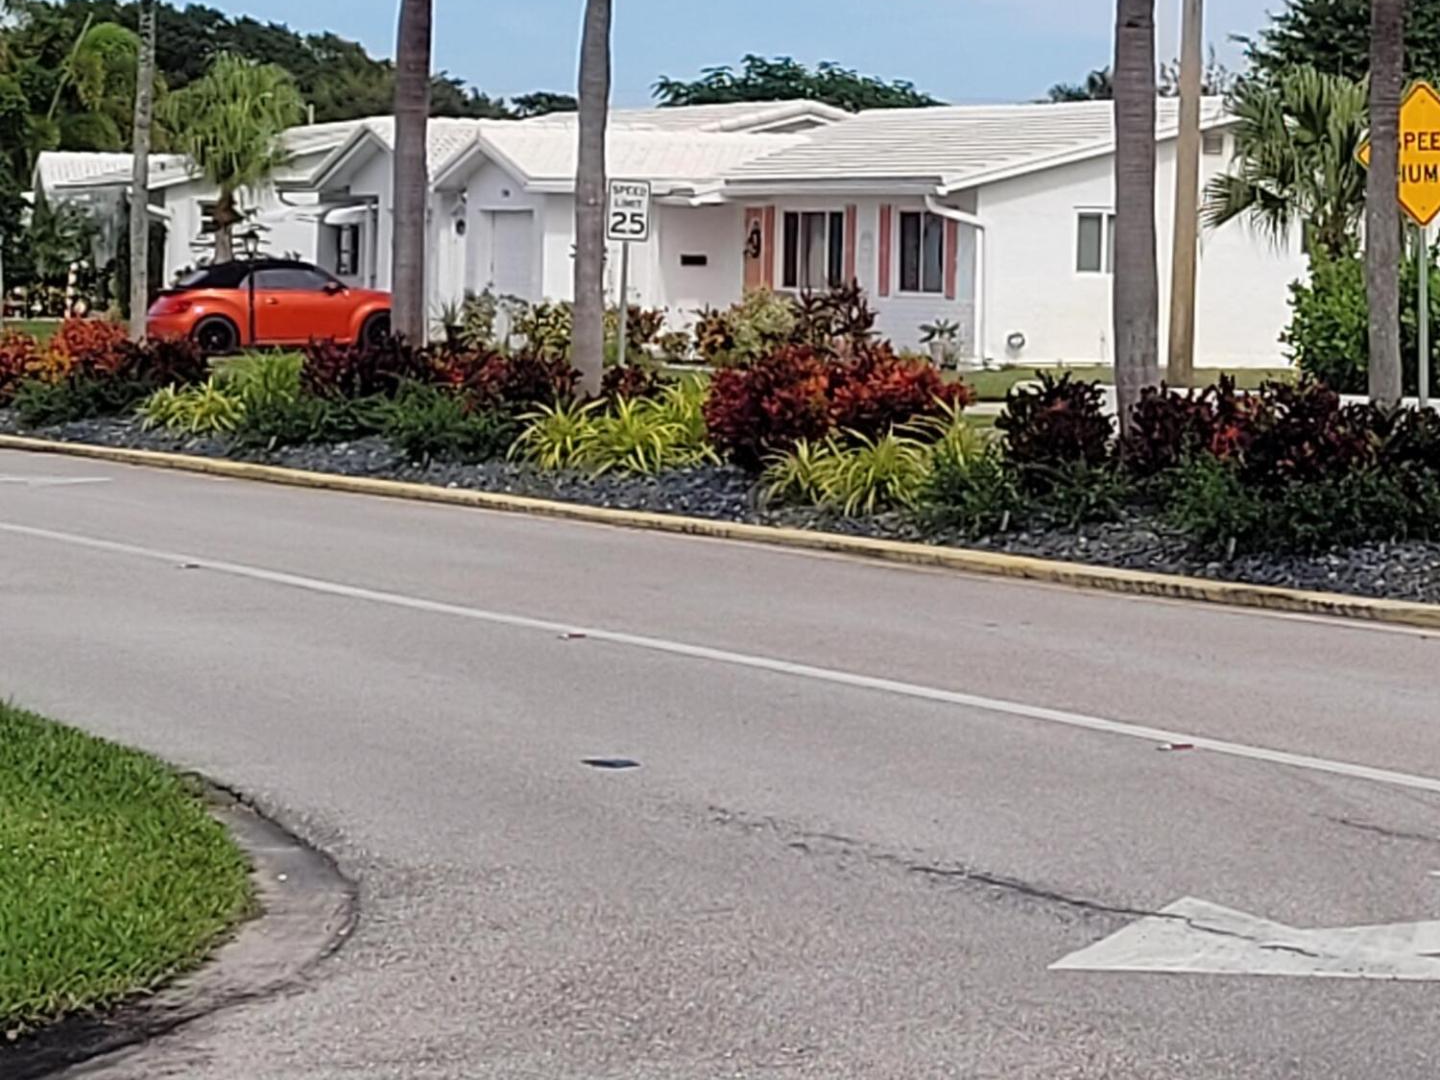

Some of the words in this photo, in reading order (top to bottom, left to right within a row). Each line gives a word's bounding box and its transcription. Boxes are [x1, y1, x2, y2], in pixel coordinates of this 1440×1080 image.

[612, 185, 648, 197] SPEED
[613, 198, 643, 208] LIMIT
[610, 211, 645, 235] 25
